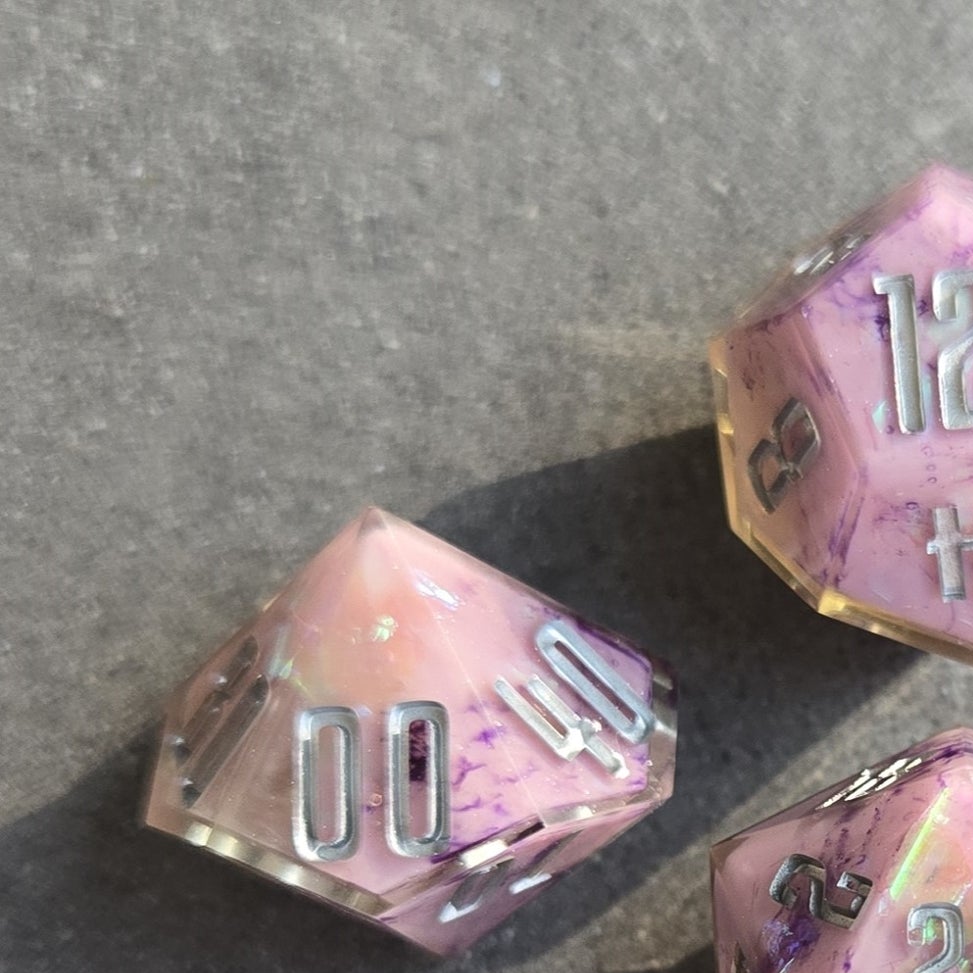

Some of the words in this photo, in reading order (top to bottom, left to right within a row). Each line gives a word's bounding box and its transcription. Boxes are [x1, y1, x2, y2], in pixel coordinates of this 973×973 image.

[748, 396, 822, 514] 8
[494, 618, 656, 779] 40
[292, 700, 452, 862] 00
[768, 853, 874, 929] 2
